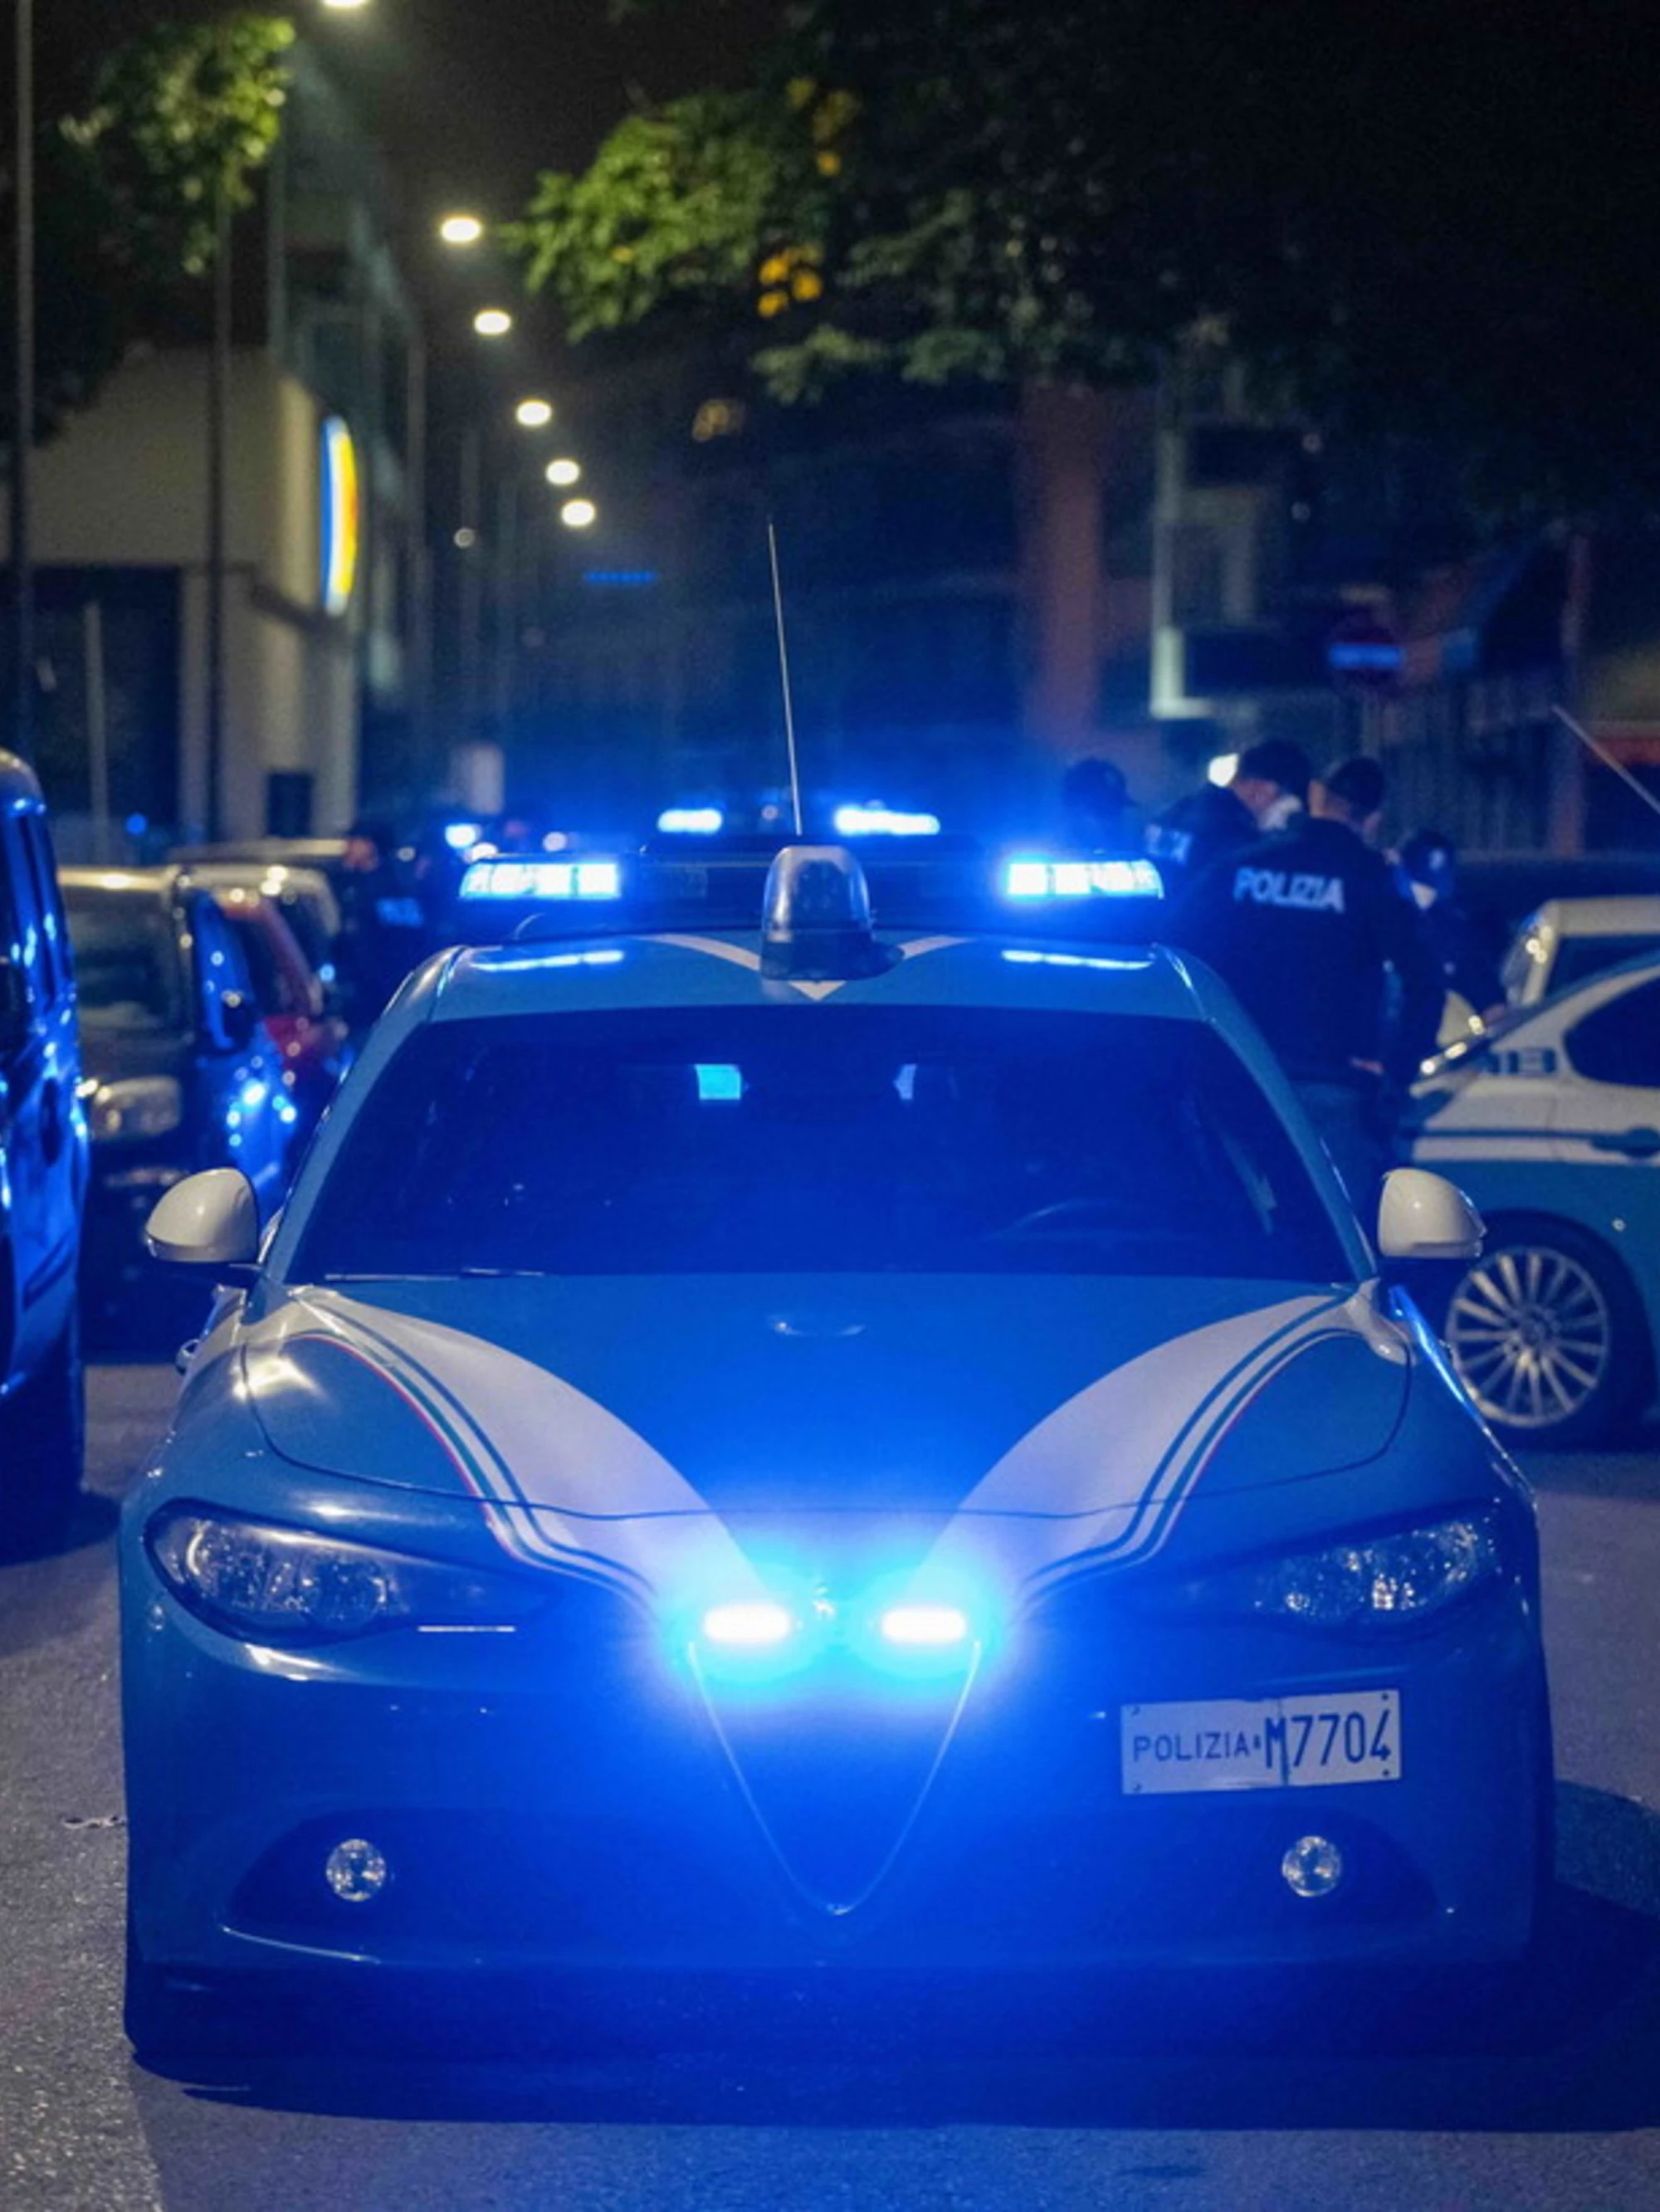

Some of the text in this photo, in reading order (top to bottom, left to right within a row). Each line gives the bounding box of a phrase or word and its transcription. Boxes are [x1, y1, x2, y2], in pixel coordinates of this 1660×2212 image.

[1234, 867, 1345, 915] POLIZIA
[1133, 1708, 1391, 1769] POLIZIA M7704
